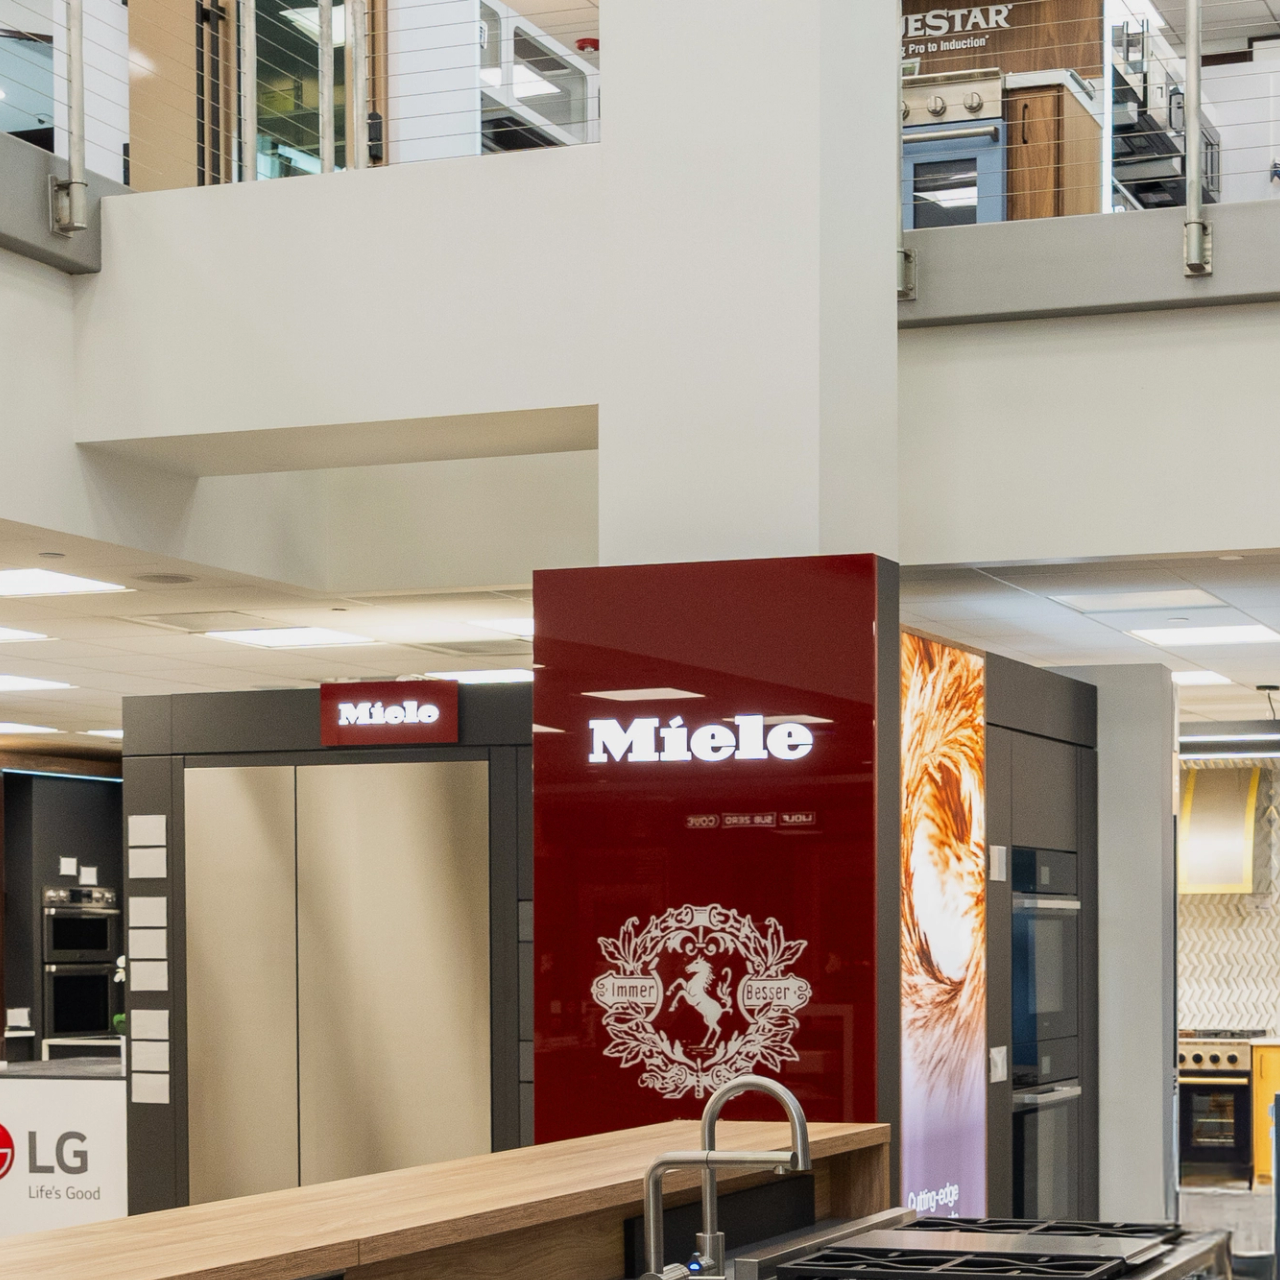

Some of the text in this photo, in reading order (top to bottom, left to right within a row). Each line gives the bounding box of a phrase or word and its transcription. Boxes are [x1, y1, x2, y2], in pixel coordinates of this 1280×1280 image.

[901, 4, 1012, 38] ESTAR
[908, 43, 926, 55] Pro
[927, 41, 938, 52] to
[940, 36, 987, 51] Induction
[338, 701, 440, 726] Miele
[588, 714, 814, 763] Miele
[612, 982, 655, 998] Immer
[746, 984, 790, 1001] Besser
[27, 1131, 88, 1175] LG
[28, 1185, 101, 1200] Life's Good
[907, 1182, 960, 1213] Cutting-edge
